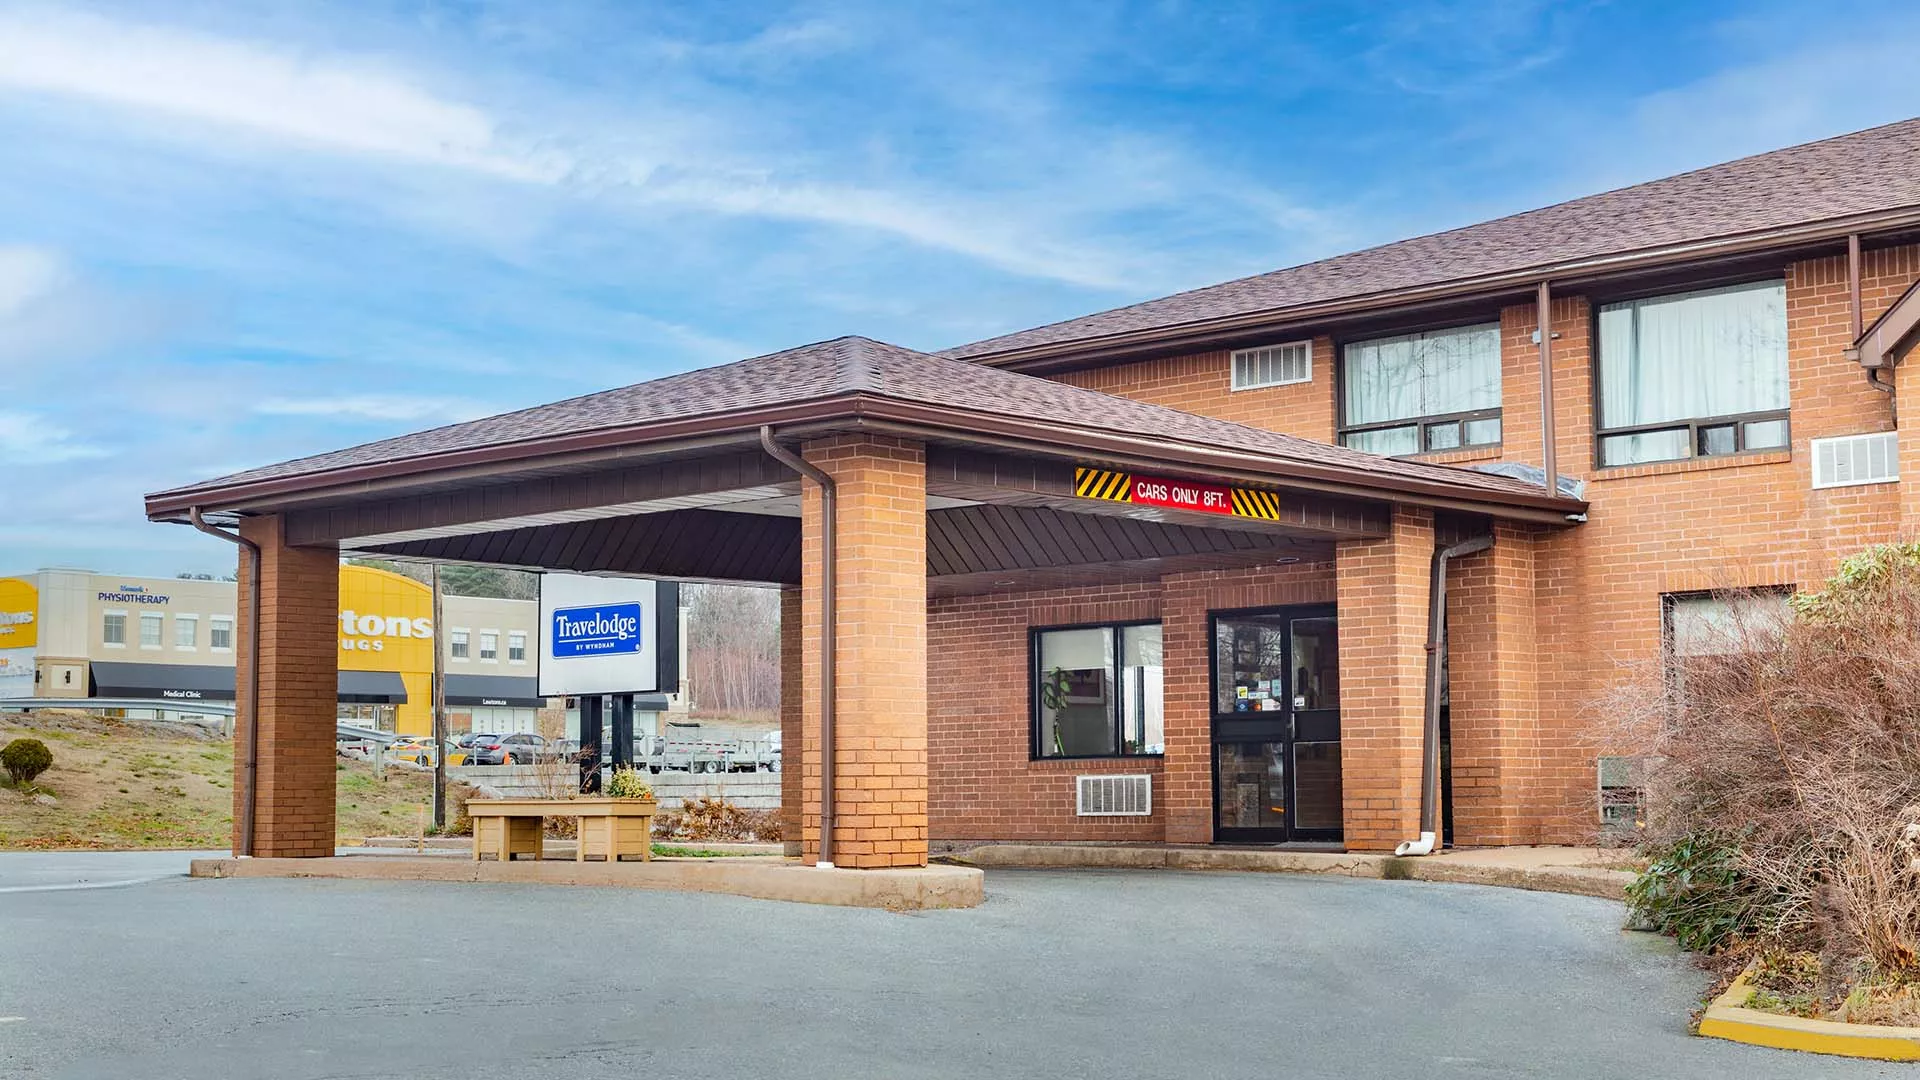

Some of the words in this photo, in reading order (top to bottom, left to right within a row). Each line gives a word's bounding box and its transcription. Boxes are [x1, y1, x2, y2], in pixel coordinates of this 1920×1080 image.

[1137, 481, 1168, 500] CARS
[1172, 487, 1199, 505] ONLY
[1203, 492, 1227, 508] 8FT.
[98, 592, 170, 604] PHYSIOTHERAPY
[338, 610, 433, 639] tons
[556, 612, 637, 640] Travelodge
[341, 638, 384, 651] UGS
[585, 642, 615, 650] WYNDHAM
[163, 690, 185, 698] Medical
[185, 690, 201, 698] Clinic
